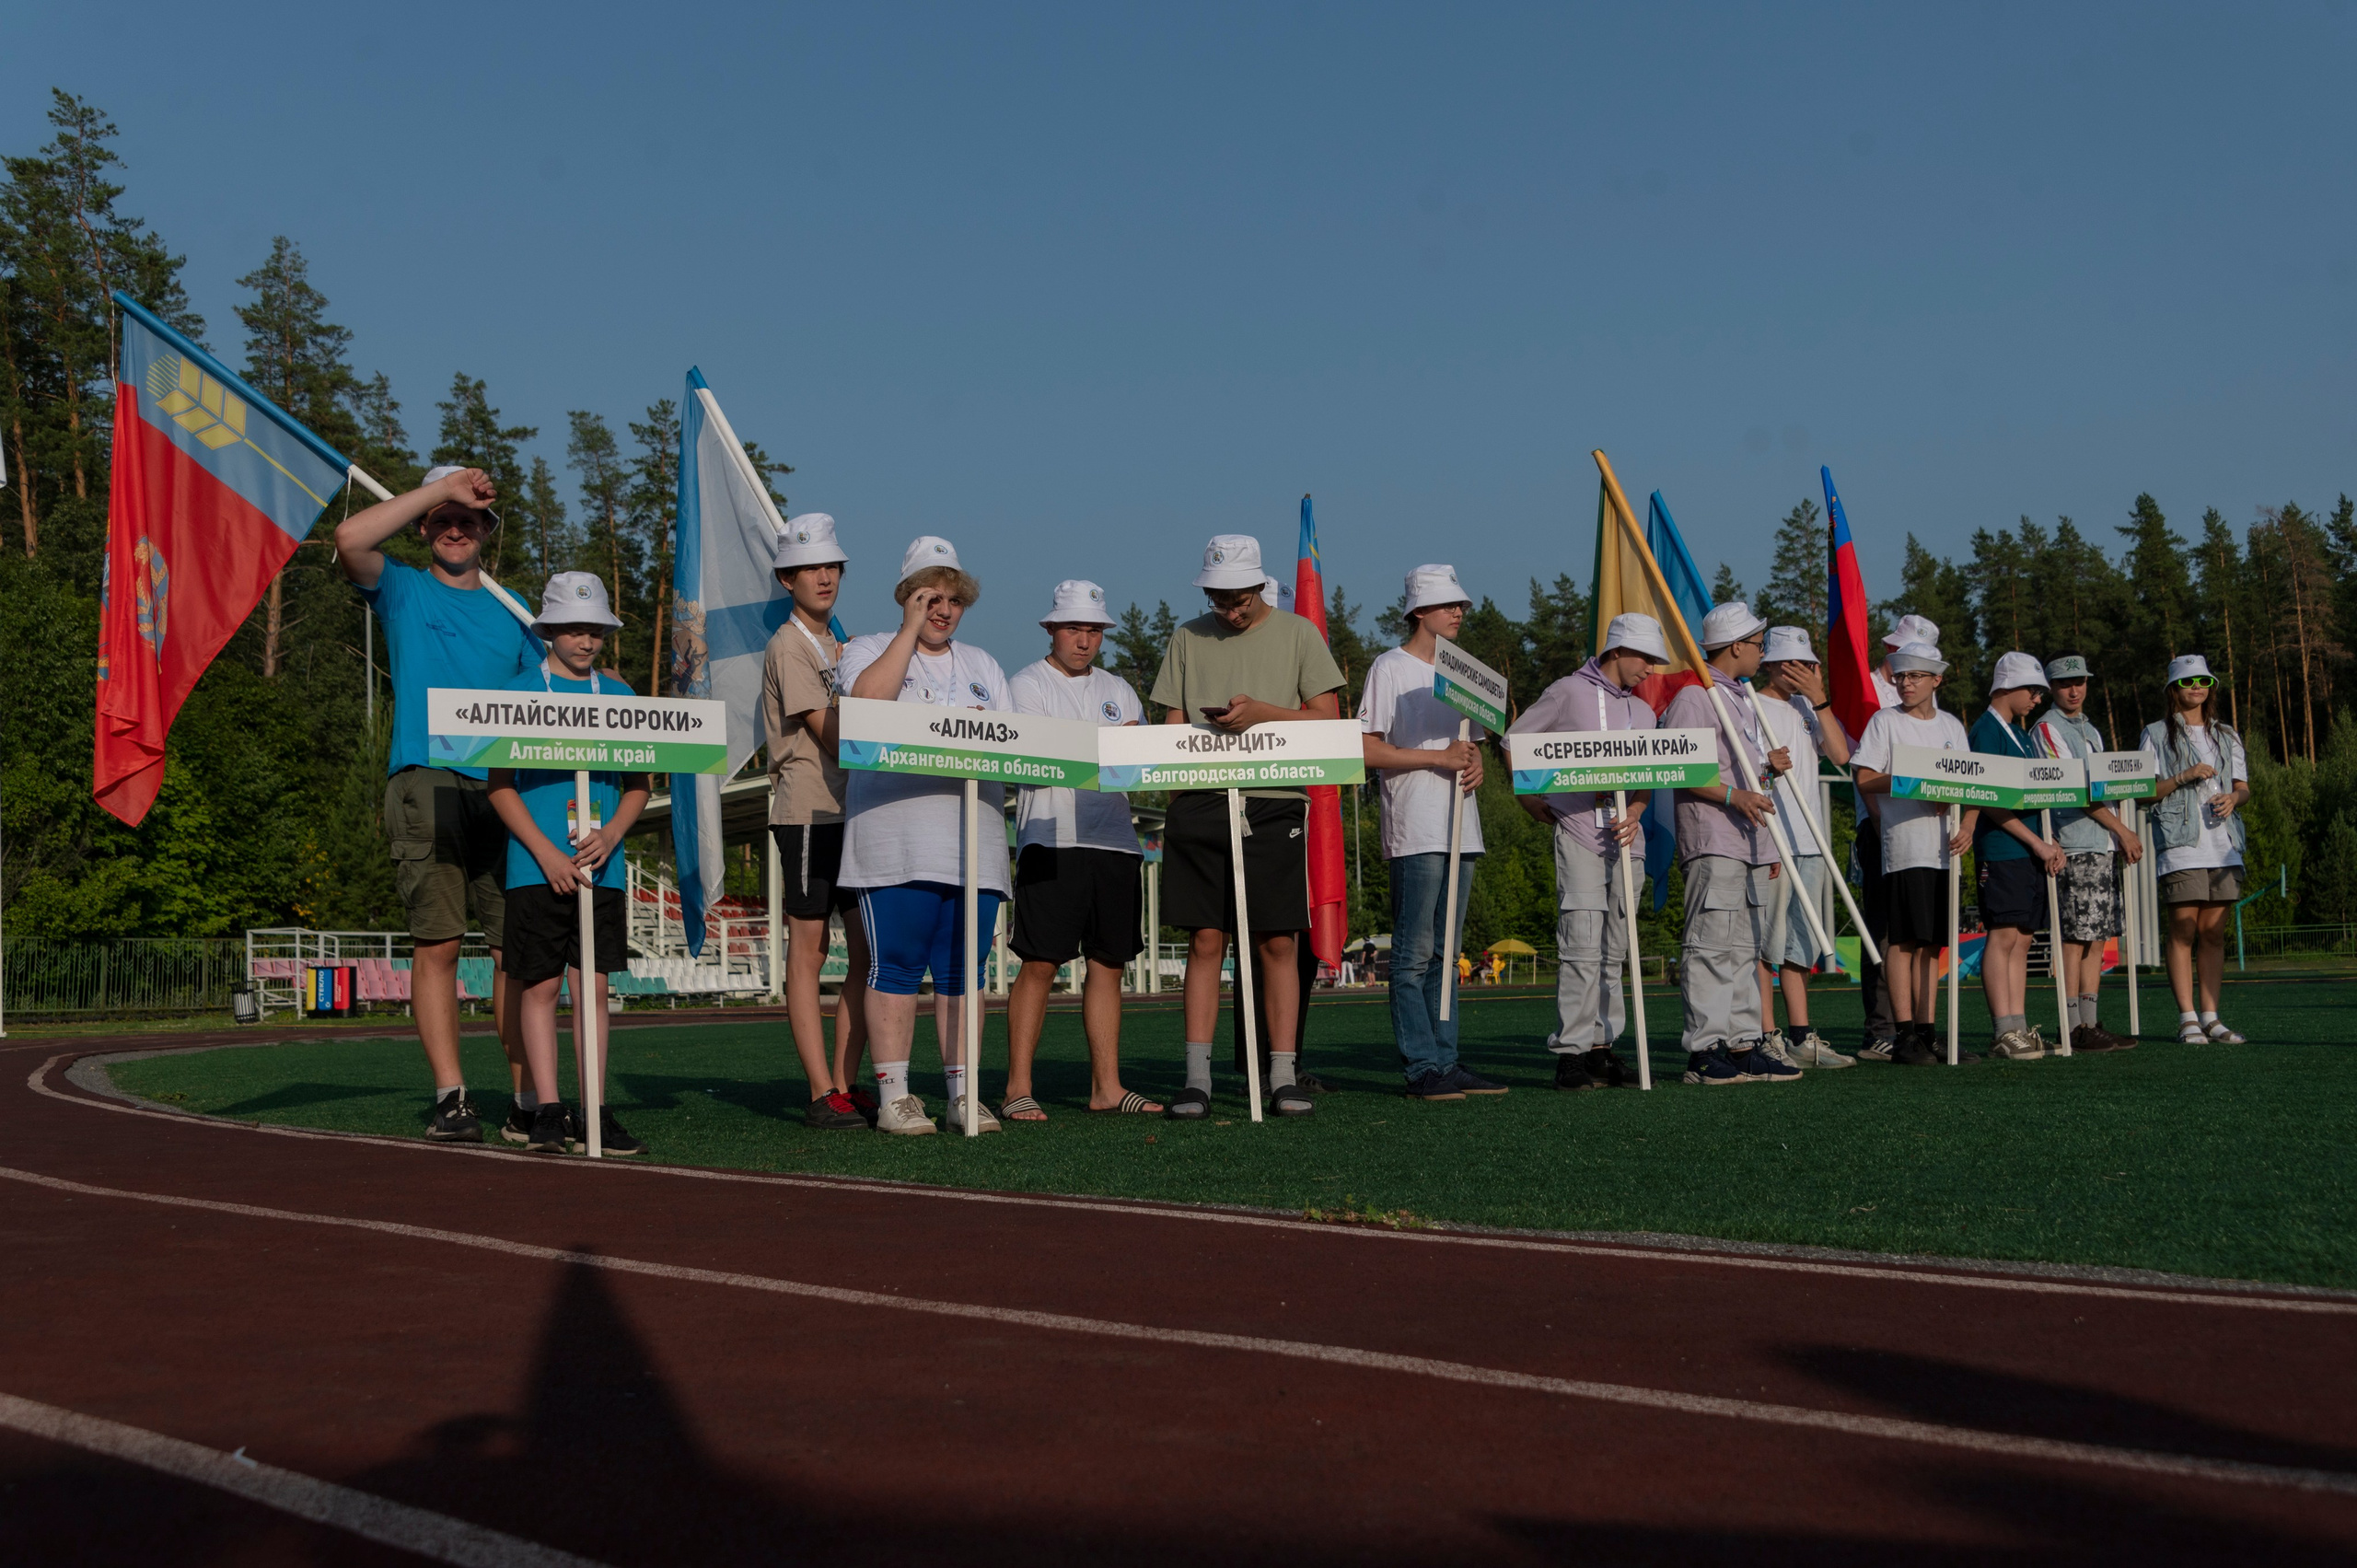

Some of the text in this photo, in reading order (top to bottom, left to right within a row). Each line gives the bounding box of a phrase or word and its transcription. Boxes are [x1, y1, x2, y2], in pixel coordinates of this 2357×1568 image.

[1445, 682, 1497, 725] Владимирская область
[455, 699, 703, 731] «АЛТАЙСКИЕ СОРОКИ»
[929, 717, 1019, 742] «АЛМАЗ»
[509, 740, 656, 767] Алтайский край
[1176, 733, 1287, 753] «КВАРЦИТ»
[1533, 735, 1698, 760] «СЕРЕБРЯНЫЙ КРАЙ»
[878, 747, 1065, 779] Архангельская область
[1141, 762, 1325, 785] Белгородская область
[1935, 758, 1985, 776] «ЧАРОИТ»
[2029, 766, 2064, 781] «КУЗБАСС»
[1553, 766, 1686, 786] Забайкальский край
[1920, 781, 1998, 801] Иркутская область
[2132, 781, 2148, 793] область
[2024, 790, 2077, 806] емеровская область
